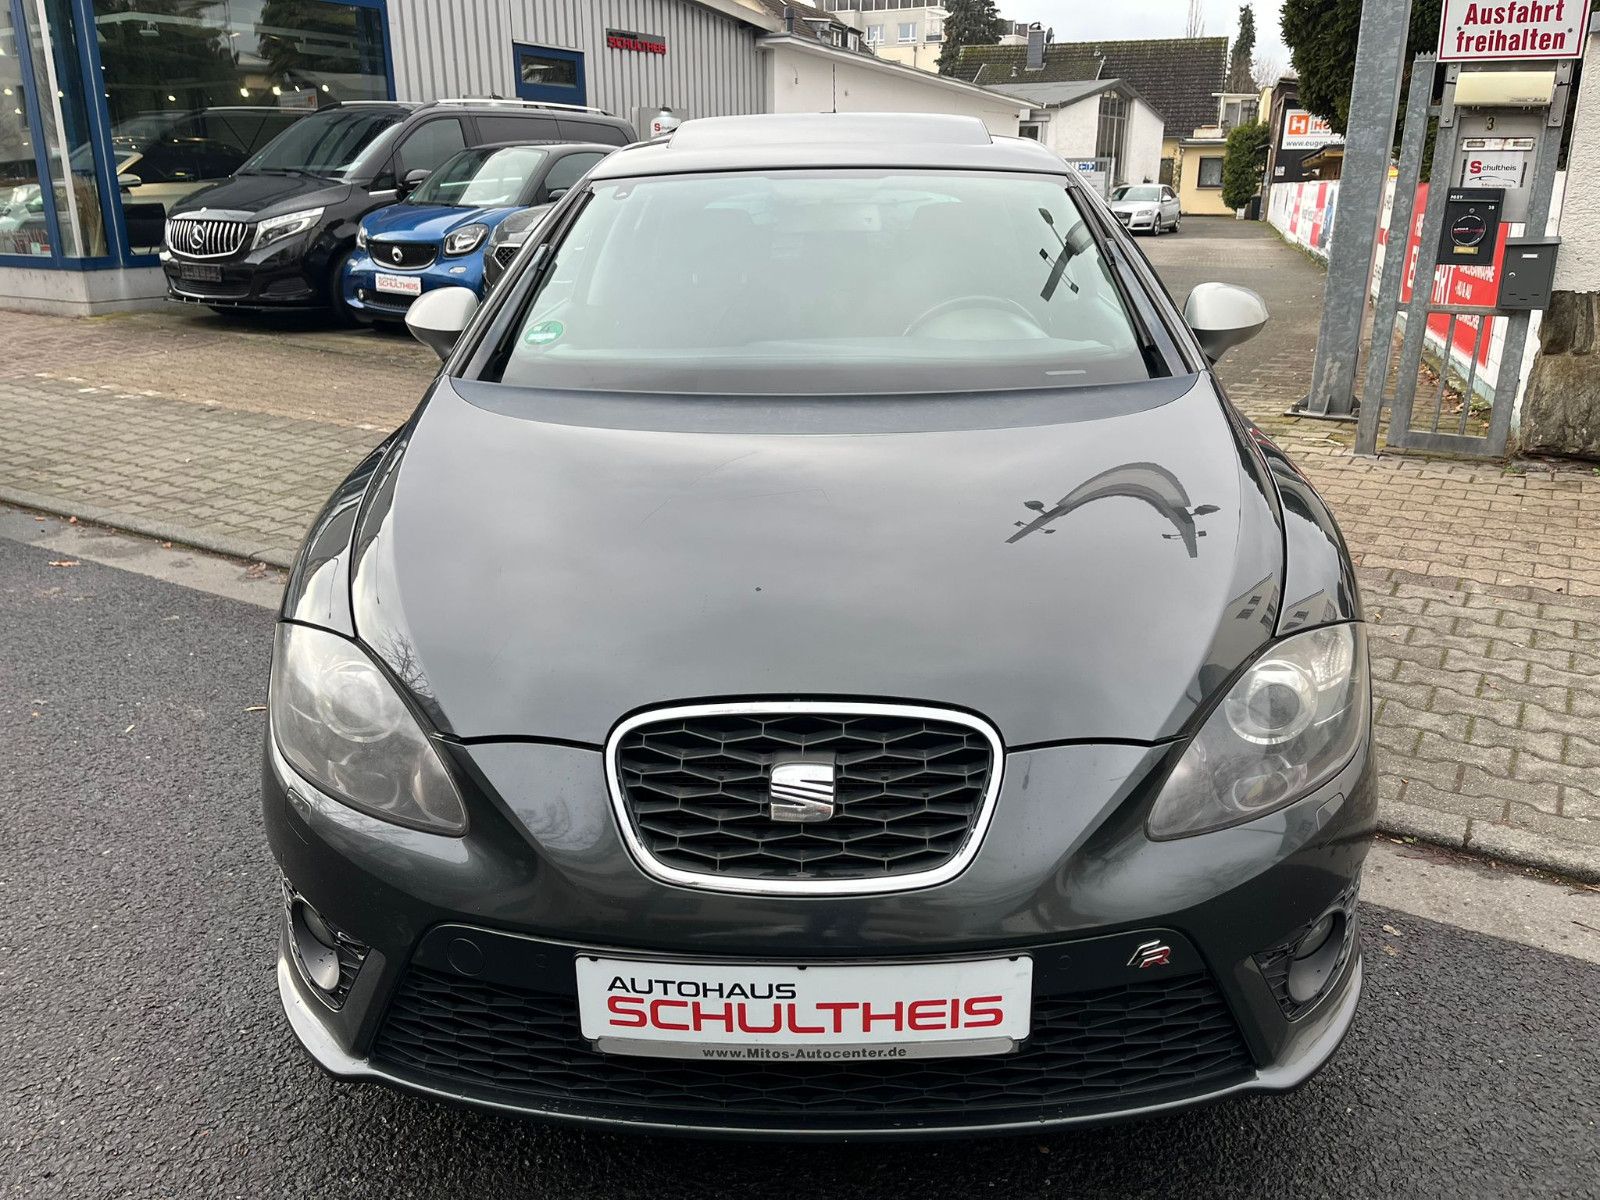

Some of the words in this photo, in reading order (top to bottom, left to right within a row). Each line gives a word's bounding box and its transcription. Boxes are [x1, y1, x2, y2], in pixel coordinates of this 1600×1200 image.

[1464, 0, 1565, 25] Ausfahrt
[1456, 28, 1566, 53] freihalten
[1486, 117, 1495, 130] 3
[1469, 161, 1517, 174] Schultheis
[607, 976, 797, 1000] AUTOHAUS
[607, 995, 1005, 1034] SCHULTHEIS
[702, 1046, 907, 1060] www.Mitos-Autocenter.de
